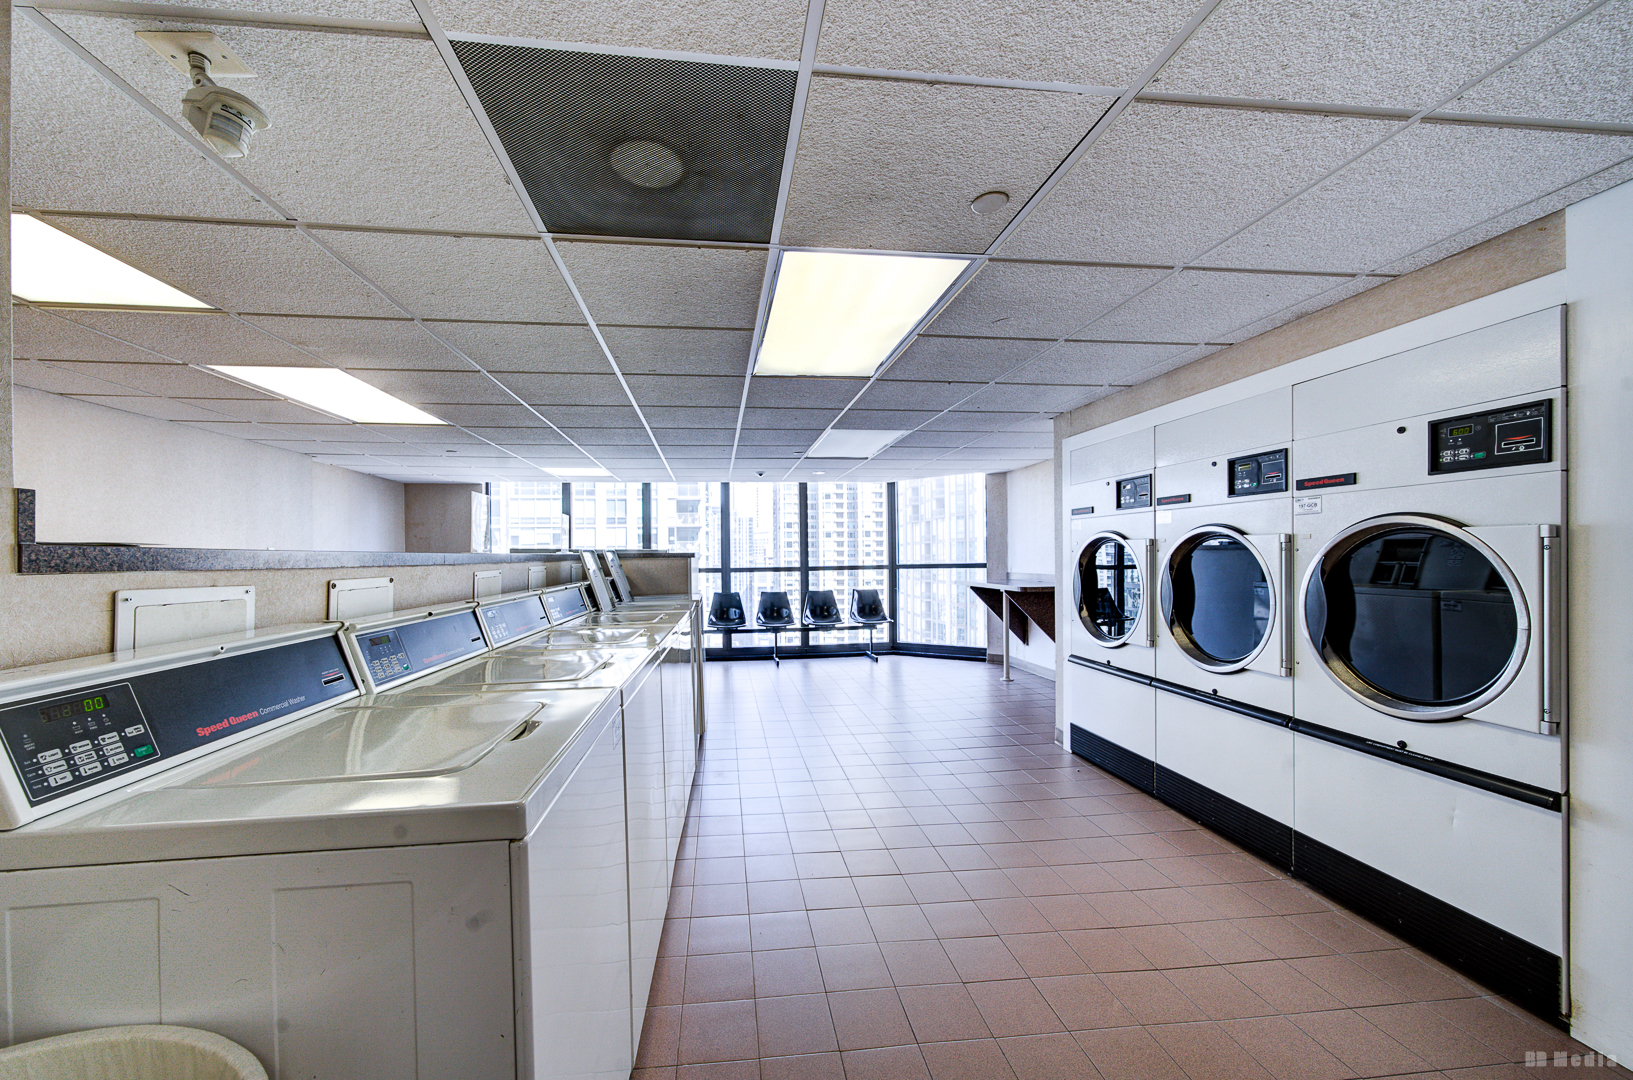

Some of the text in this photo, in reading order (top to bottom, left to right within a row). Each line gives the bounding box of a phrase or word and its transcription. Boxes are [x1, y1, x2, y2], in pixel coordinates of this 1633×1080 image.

[1304, 479, 1323, 487] Speed
[83, 696, 104, 712] 00
[196, 696, 306, 736] Speed Queen Commercial Washer
